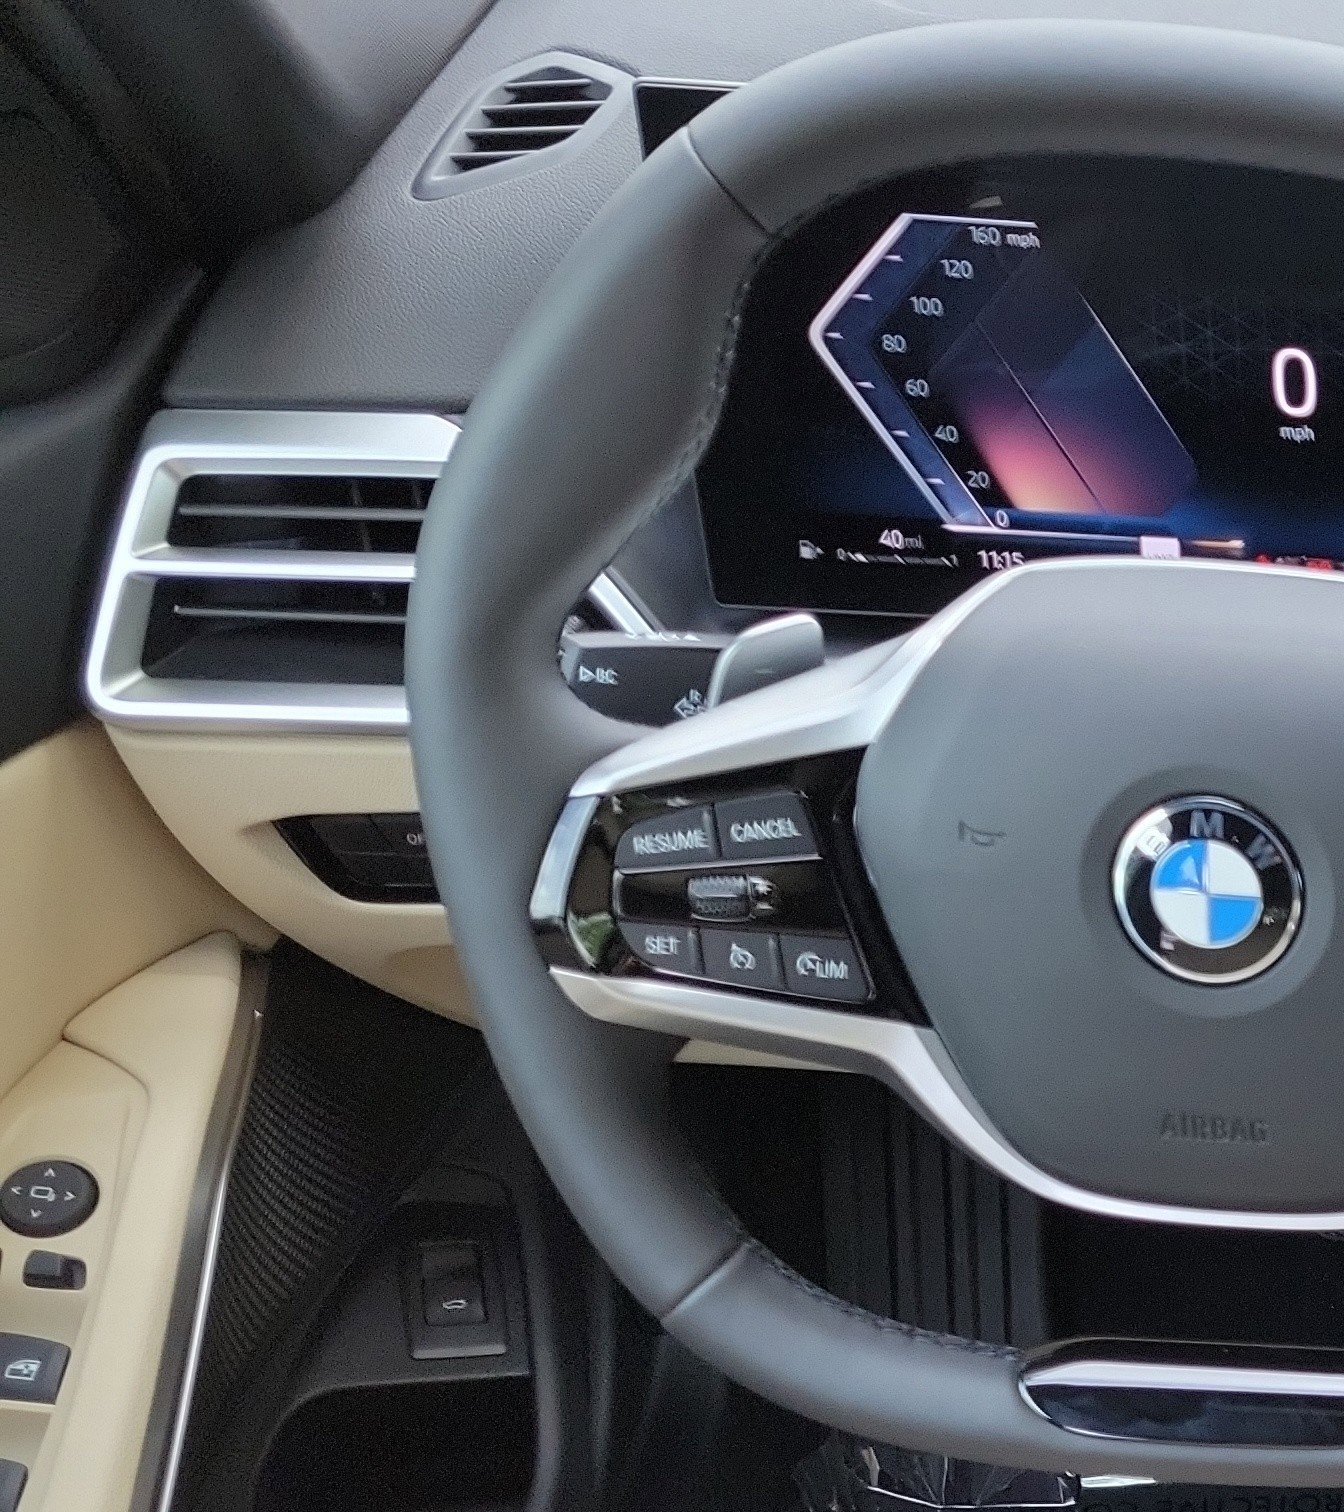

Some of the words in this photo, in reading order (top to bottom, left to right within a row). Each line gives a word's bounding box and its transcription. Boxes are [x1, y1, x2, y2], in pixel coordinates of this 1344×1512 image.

[969, 226, 1000, 246] 160
[1006, 233, 1040, 249] mph
[942, 259, 973, 280] 120
[910, 297, 943, 317] 100
[882, 334, 907, 354] 80
[906, 379, 929, 398] 60
[1272, 346, 1318, 417] 0
[935, 425, 959, 444] 40
[1279, 423, 1315, 443] mph
[968, 471, 990, 489] 20
[995, 509, 1010, 527] 0
[879, 530, 904, 548] 40
[977, 551, 1025, 570] 11:15
[730, 817, 802, 843] CANCEL
[1136, 809, 1282, 870] BMW
[632, 830, 710, 854] RESUME
[645, 936, 680, 954] SET
[816, 957, 849, 980] LIM
[1160, 1112, 1267, 1143] AIRBAG
